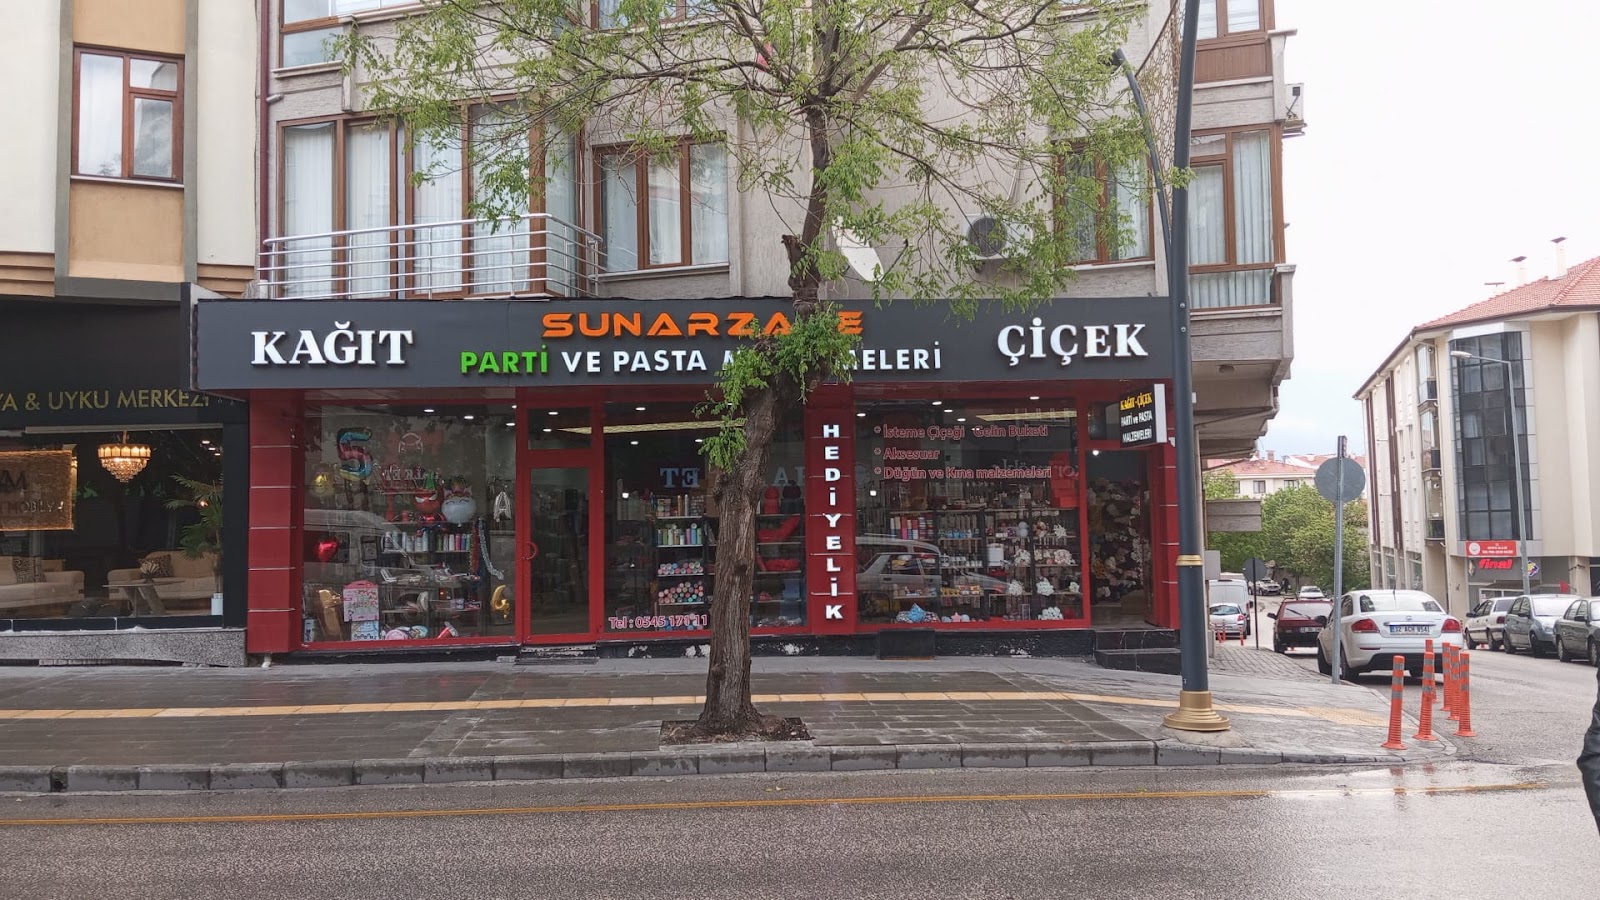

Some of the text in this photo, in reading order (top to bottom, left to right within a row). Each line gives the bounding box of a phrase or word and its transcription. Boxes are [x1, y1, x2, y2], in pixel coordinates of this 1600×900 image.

[542, 311, 864, 337] SUNARZAE
[251, 321, 412, 365] KAĞIT
[997, 317, 1148, 366] ÇİÇEK
[461, 341, 942, 373] PARTİ VE PASTA MMELERİ
[25, 392, 40, 410] &
[49, 390, 108, 410] UYKU
[974, 425, 1006, 437] Gelin
[1008, 424, 1048, 437] Buketi
[883, 447, 940, 460] Aksesuar
[884, 466, 926, 482] Düğün
[928, 469, 944, 479] ve
[976, 465, 1052, 479] malzemeleri
[608, 616, 628, 630] Tel
[634, 615, 666, 629] 0545
